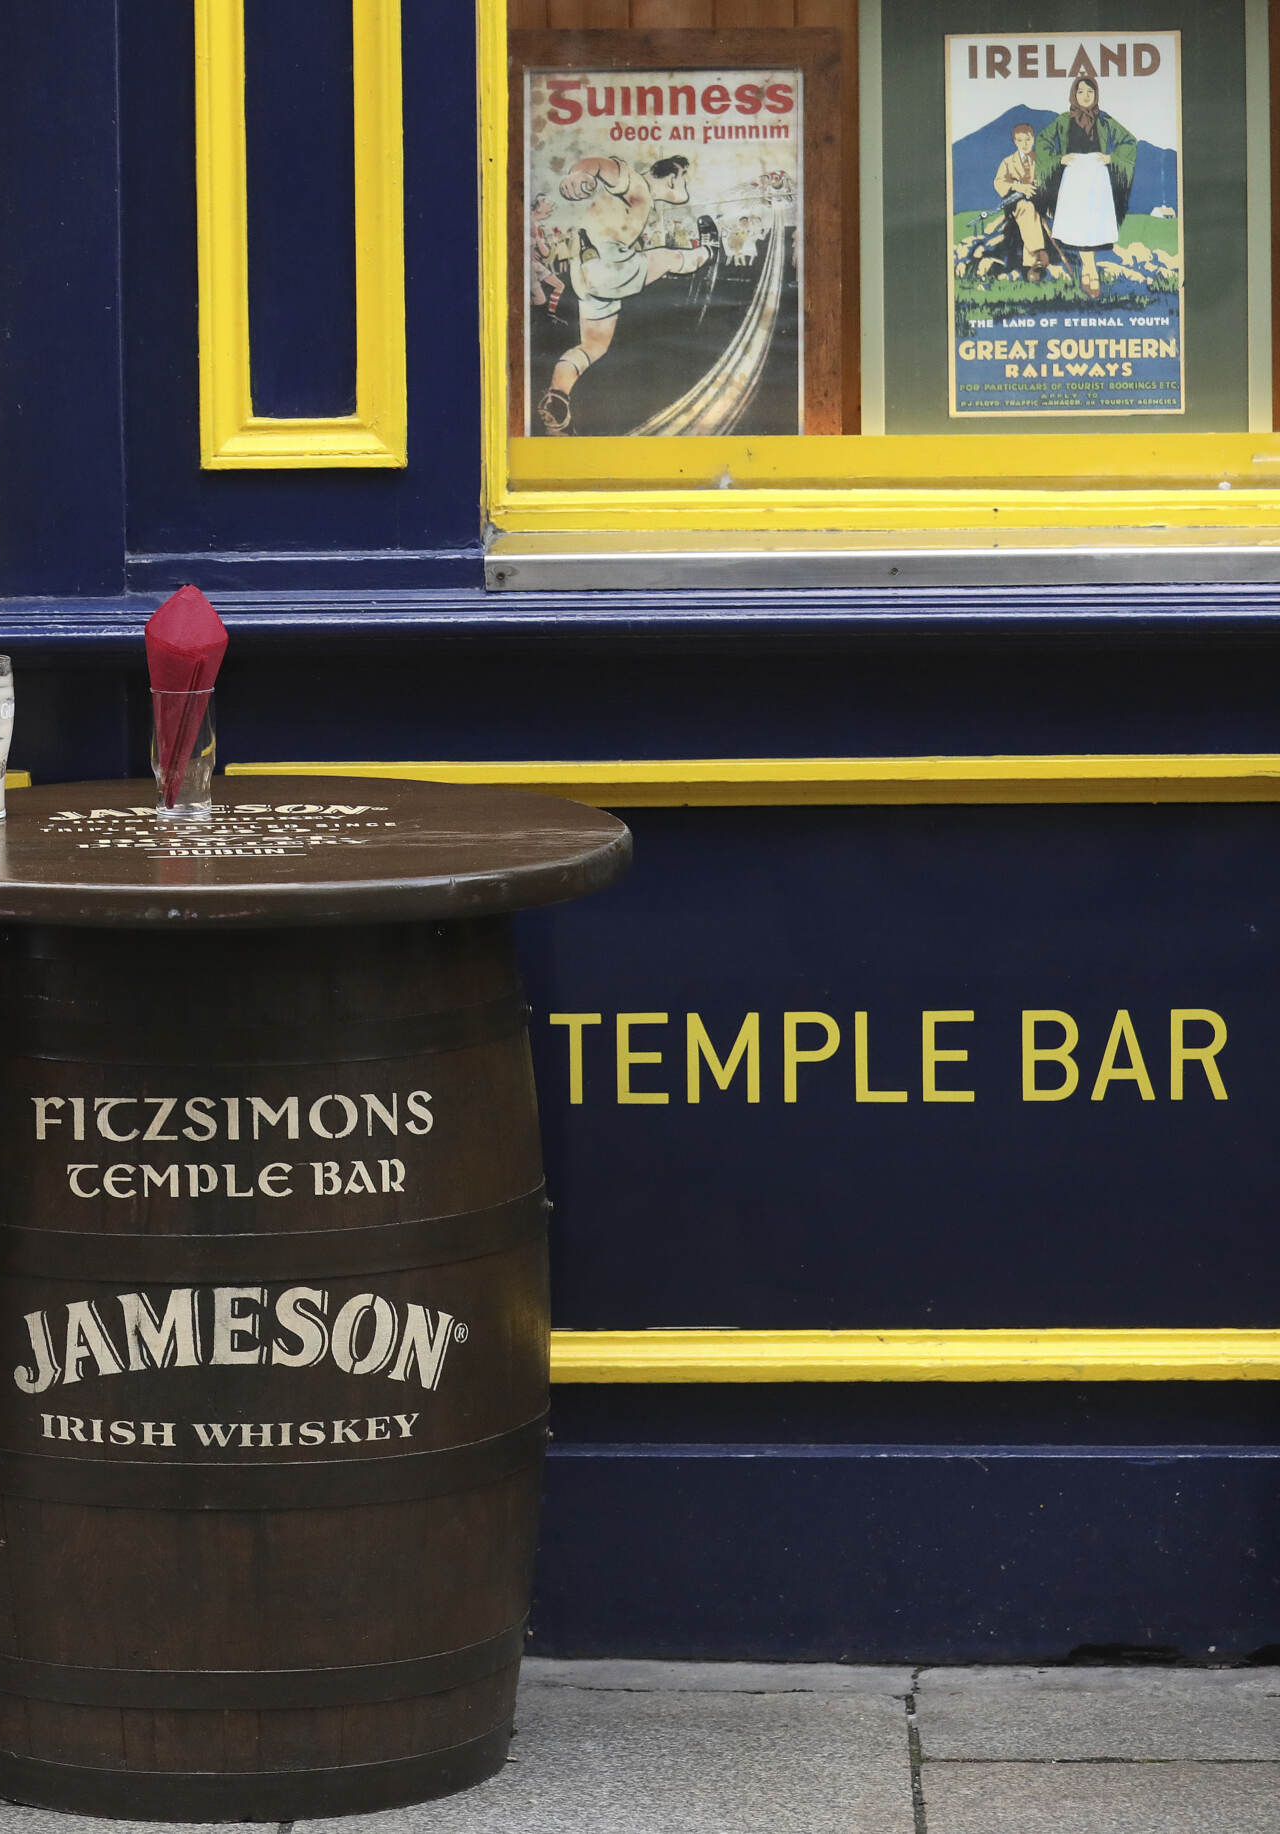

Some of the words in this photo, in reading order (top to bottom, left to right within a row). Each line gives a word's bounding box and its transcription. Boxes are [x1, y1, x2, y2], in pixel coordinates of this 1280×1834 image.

[967, 42, 1161, 79] IRELAND
[969, 317, 994, 328] THE
[1002, 317, 1036, 328] LAND
[1039, 317, 1058, 328] OF
[1064, 317, 1124, 328] ETERNAL
[1129, 316, 1170, 327] YOUTH
[958, 339, 1039, 361] GREAT
[1046, 337, 1179, 360] SOUTHERN
[1005, 362, 1133, 379] RAILWAYS
[959, 384, 981, 393] FOR
[983, 383, 1048, 392] PARTICULARS
[1051, 382, 1063, 391] OF
[1066, 382, 1105, 391] TOURIST
[169, 848, 286, 857] DUBLIN
[549, 1009, 975, 1105] TEMPLE
[1021, 1008, 1229, 1102] BAR
[31, 1090, 434, 1142] FITZSIMONS
[67, 1162, 293, 1199] TEMPLE
[310, 1158, 406, 1196] BAR
[41, 1413, 177, 1447] IRISH
[192, 1412, 420, 1448] WHISKEY
